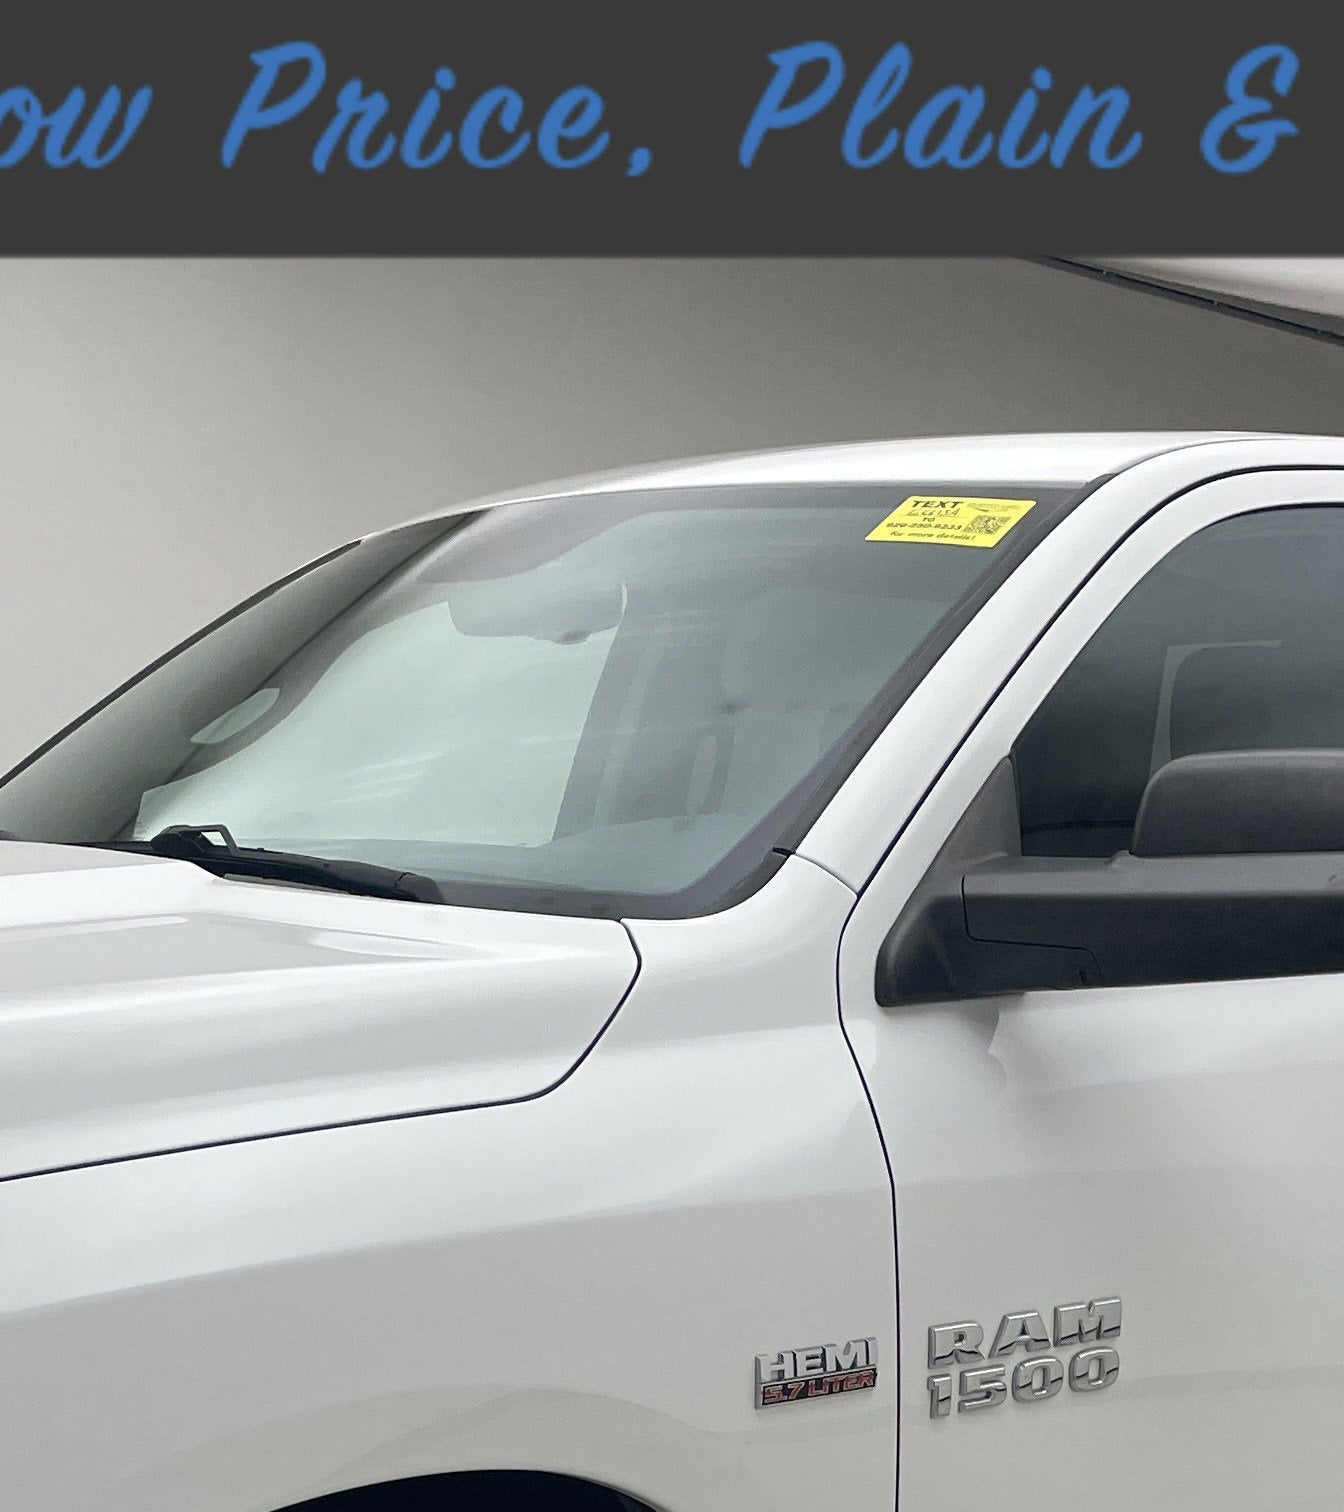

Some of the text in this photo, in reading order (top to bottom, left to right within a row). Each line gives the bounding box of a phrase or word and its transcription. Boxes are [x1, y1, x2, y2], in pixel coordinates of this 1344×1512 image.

[911, 500, 964, 509] TEXT
[927, 1296, 1122, 1369] RAM
[755, 1336, 877, 1383] HEMI
[927, 1346, 1120, 1419] 1500
[762, 1369, 875, 1405] 5.7 LITER
